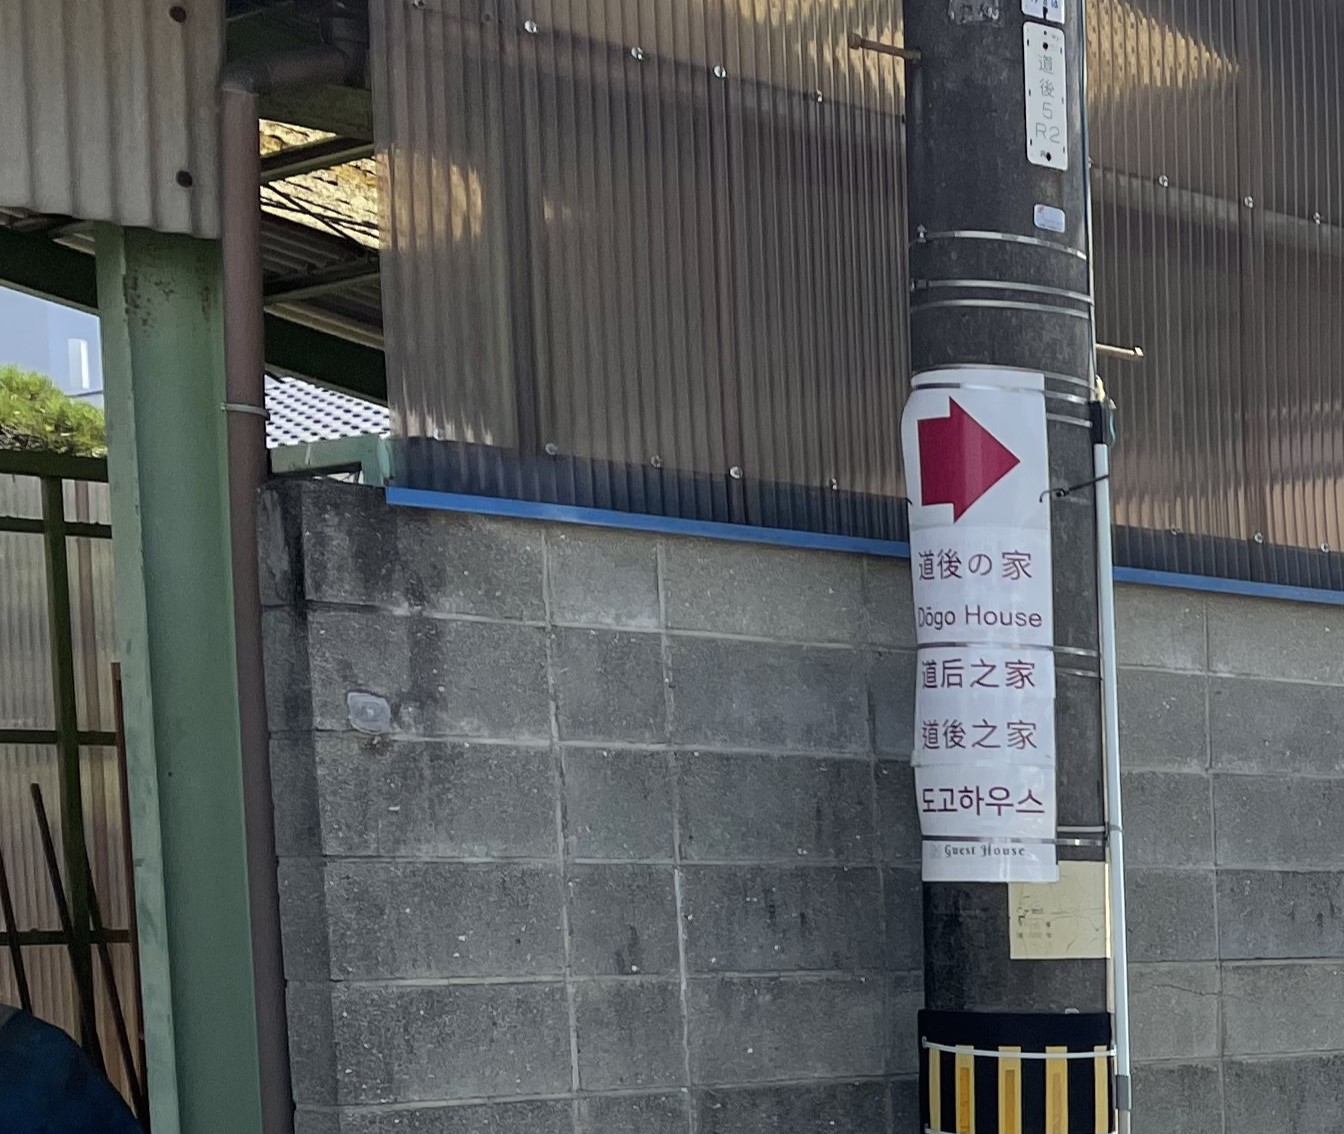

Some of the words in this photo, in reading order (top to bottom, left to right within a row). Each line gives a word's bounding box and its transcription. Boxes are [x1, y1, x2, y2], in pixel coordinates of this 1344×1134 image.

[918, 548, 1032, 581] 道後の家
[964, 603, 1043, 628] House
[921, 658, 1036, 690] 道后之家
[921, 718, 1038, 750] 道後之家
[922, 785, 1045, 816] 도고하우스
[944, 844, 976, 858] Guest
[979, 841, 1026, 857] House
